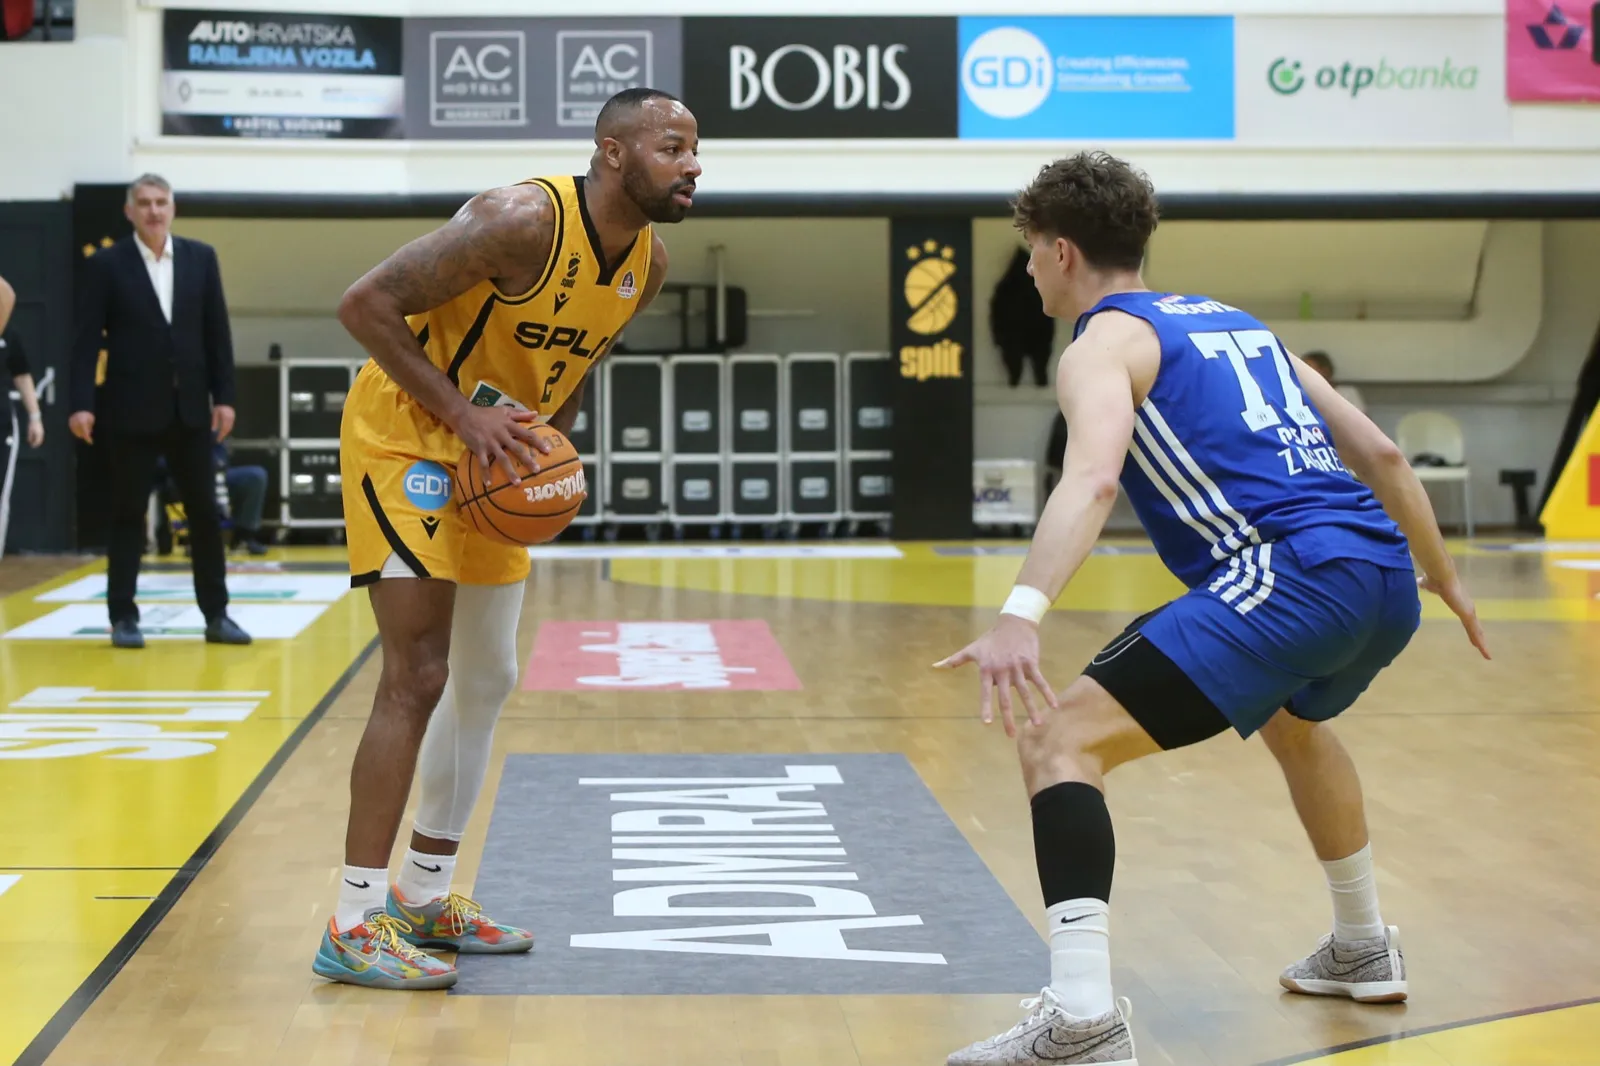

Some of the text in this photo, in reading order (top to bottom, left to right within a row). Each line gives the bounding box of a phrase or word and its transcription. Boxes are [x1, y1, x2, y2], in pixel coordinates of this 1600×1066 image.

[188, 20, 356, 45] AUTOHRVATSKA
[188, 46, 376, 69] RABLJENA VOZILA
[443, 44, 513, 80] AC
[570, 44, 640, 80] AC
[969, 53, 1047, 89] GDi
[1056, 56, 1111, 71] Creating
[442, 82, 513, 96] HOTELS
[729, 43, 911, 111] BOBIS
[1057, 72, 1131, 87] Stimulating
[900, 338, 963, 381] split
[540, 361, 567, 403] 2
[1187, 330, 1320, 433] 77
[1277, 446, 1349, 477] ZAGRE
[406, 474, 450, 497] GDi
[569, 764, 949, 965] ADMIRAL
